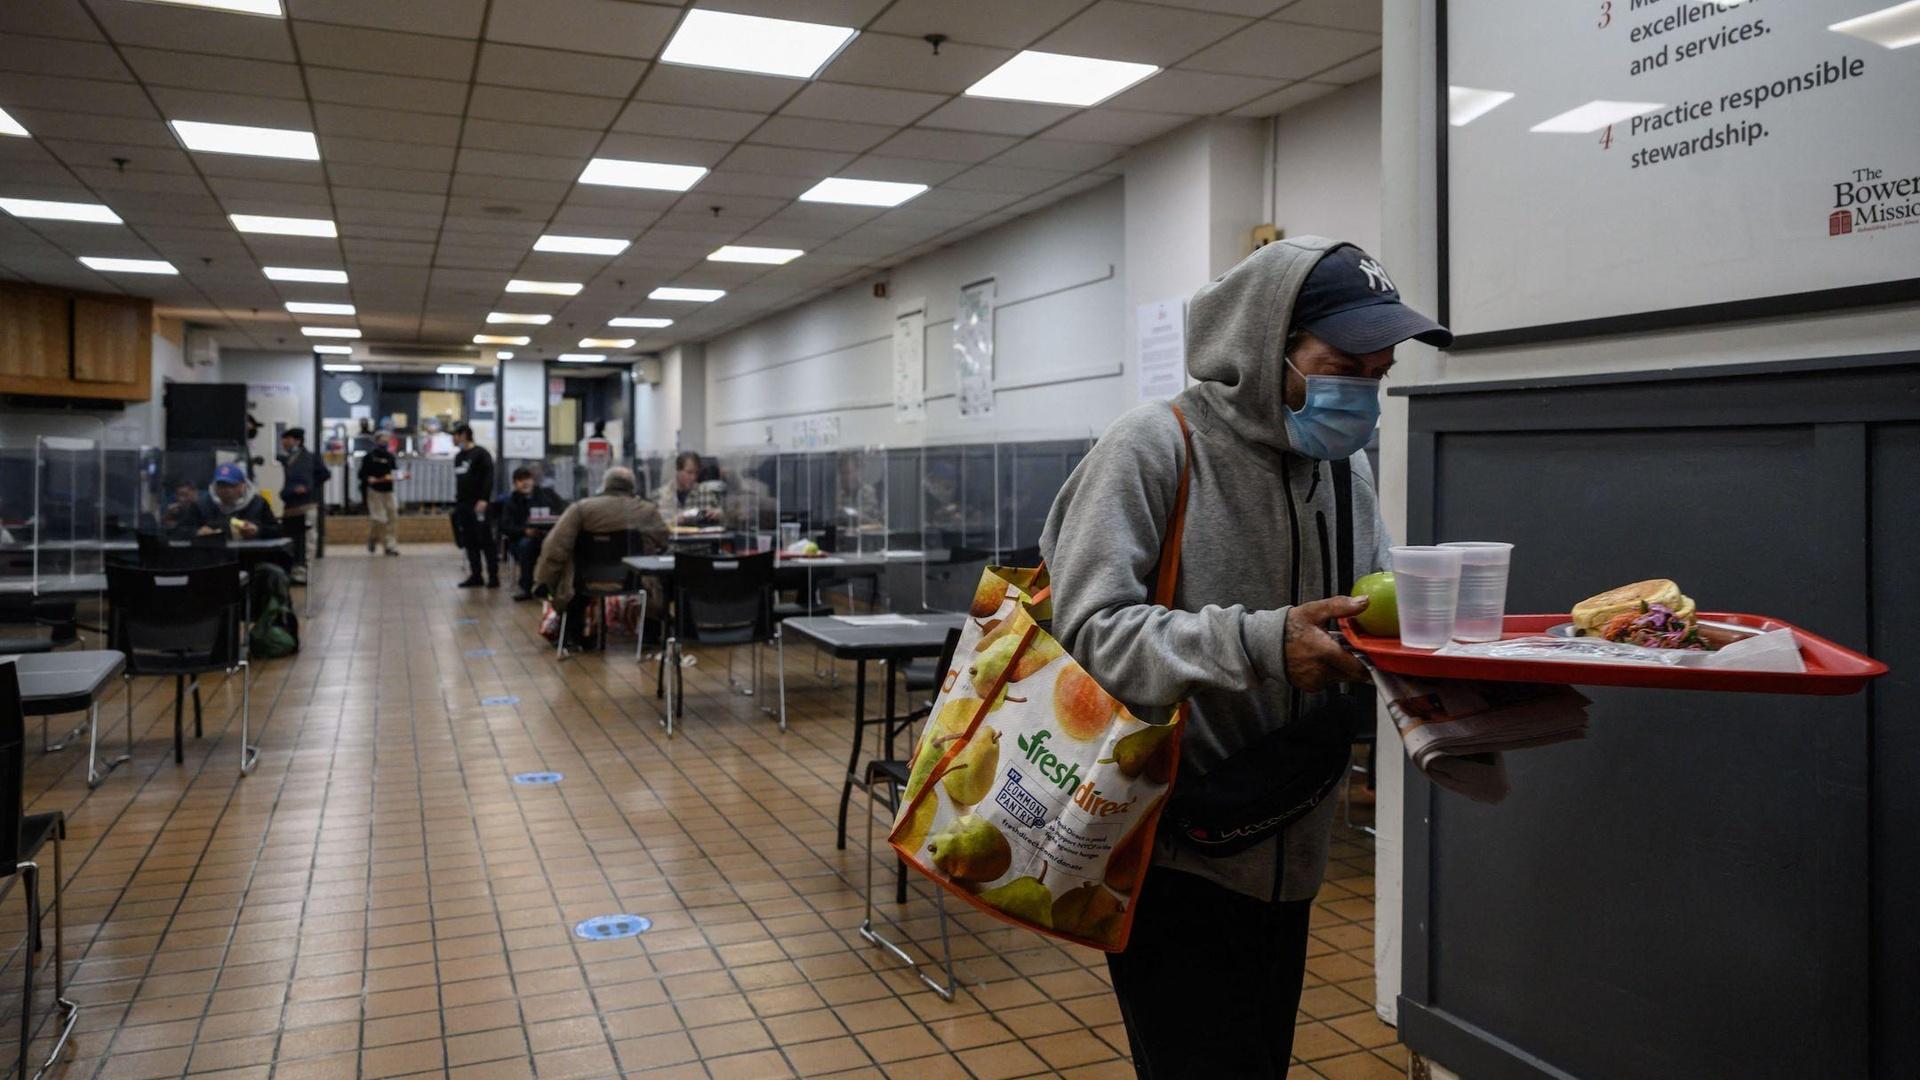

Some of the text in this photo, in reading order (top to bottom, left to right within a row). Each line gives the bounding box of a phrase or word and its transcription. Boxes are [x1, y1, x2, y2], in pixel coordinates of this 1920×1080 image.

[1598, 0, 1612, 30] 3
[1630, 1, 1740, 43] excellenc
[1630, 18, 1771, 76] and services.
[1599, 56, 1865, 150] 4 Practice responsible
[1631, 120, 1770, 169] stewardship.
[1852, 167, 1882, 183] The
[1359, 259, 1394, 291] NY
[999, 792, 1034, 824] PANTRY
[1006, 781, 1043, 816] COMMON
